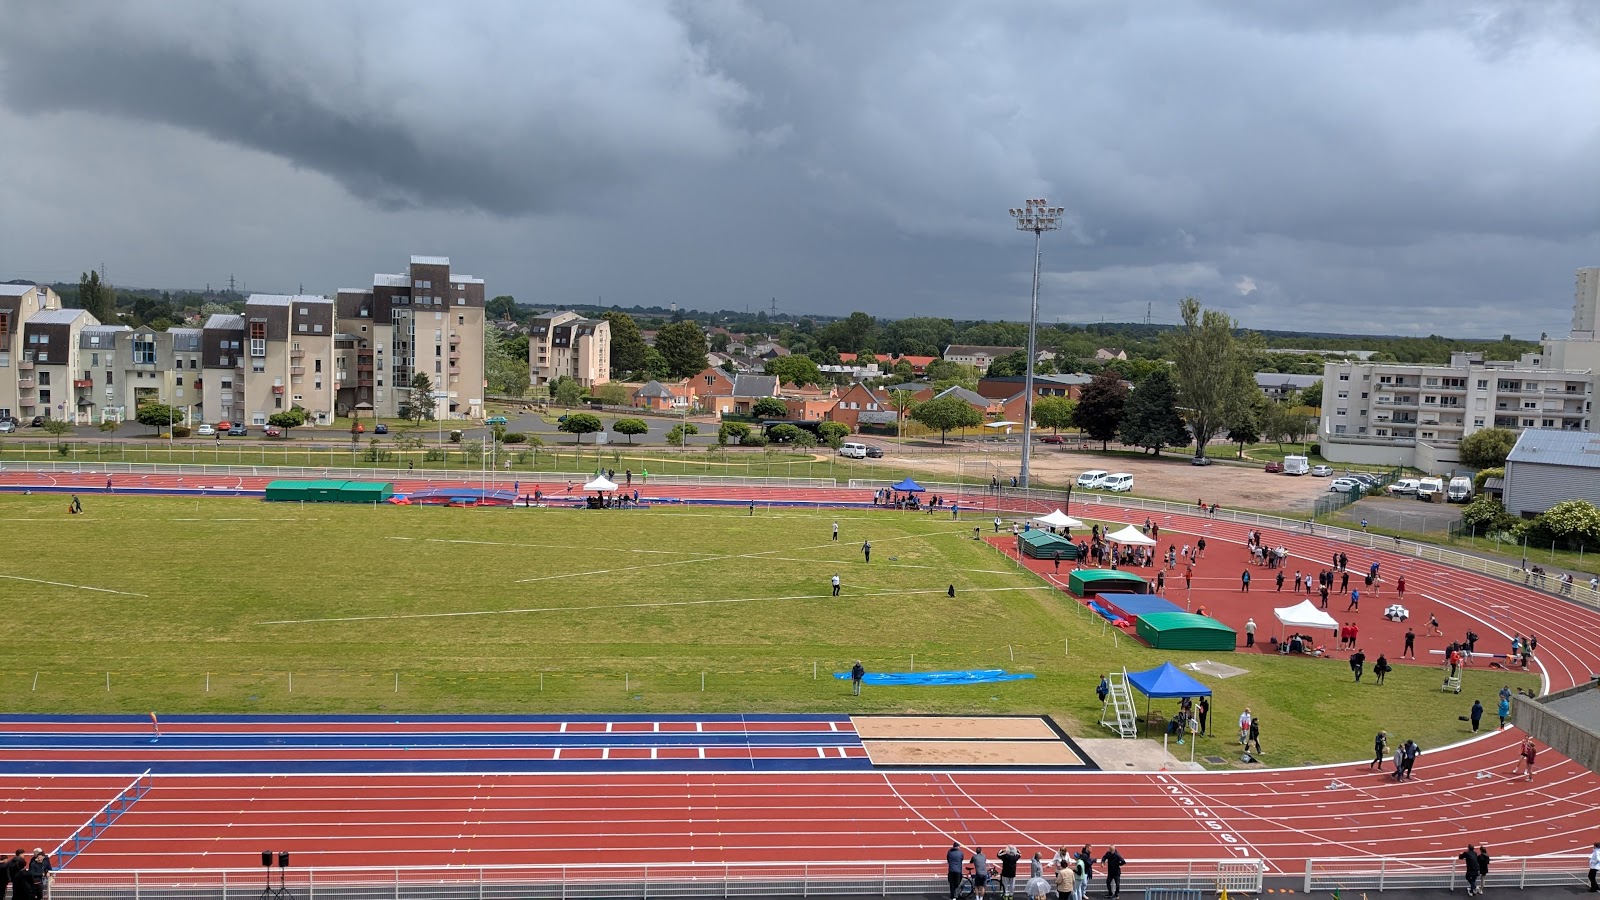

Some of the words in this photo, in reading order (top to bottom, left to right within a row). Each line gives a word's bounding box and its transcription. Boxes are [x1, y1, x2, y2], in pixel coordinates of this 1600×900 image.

[1157, 775, 1168, 783] 1
[1167, 785, 1183, 794] 2
[1179, 797, 1195, 805] 3
[1194, 808, 1208, 817] 4
[1205, 820, 1222, 830] 5
[1220, 833, 1237, 843] 6
[1234, 847, 1249, 856] 7
